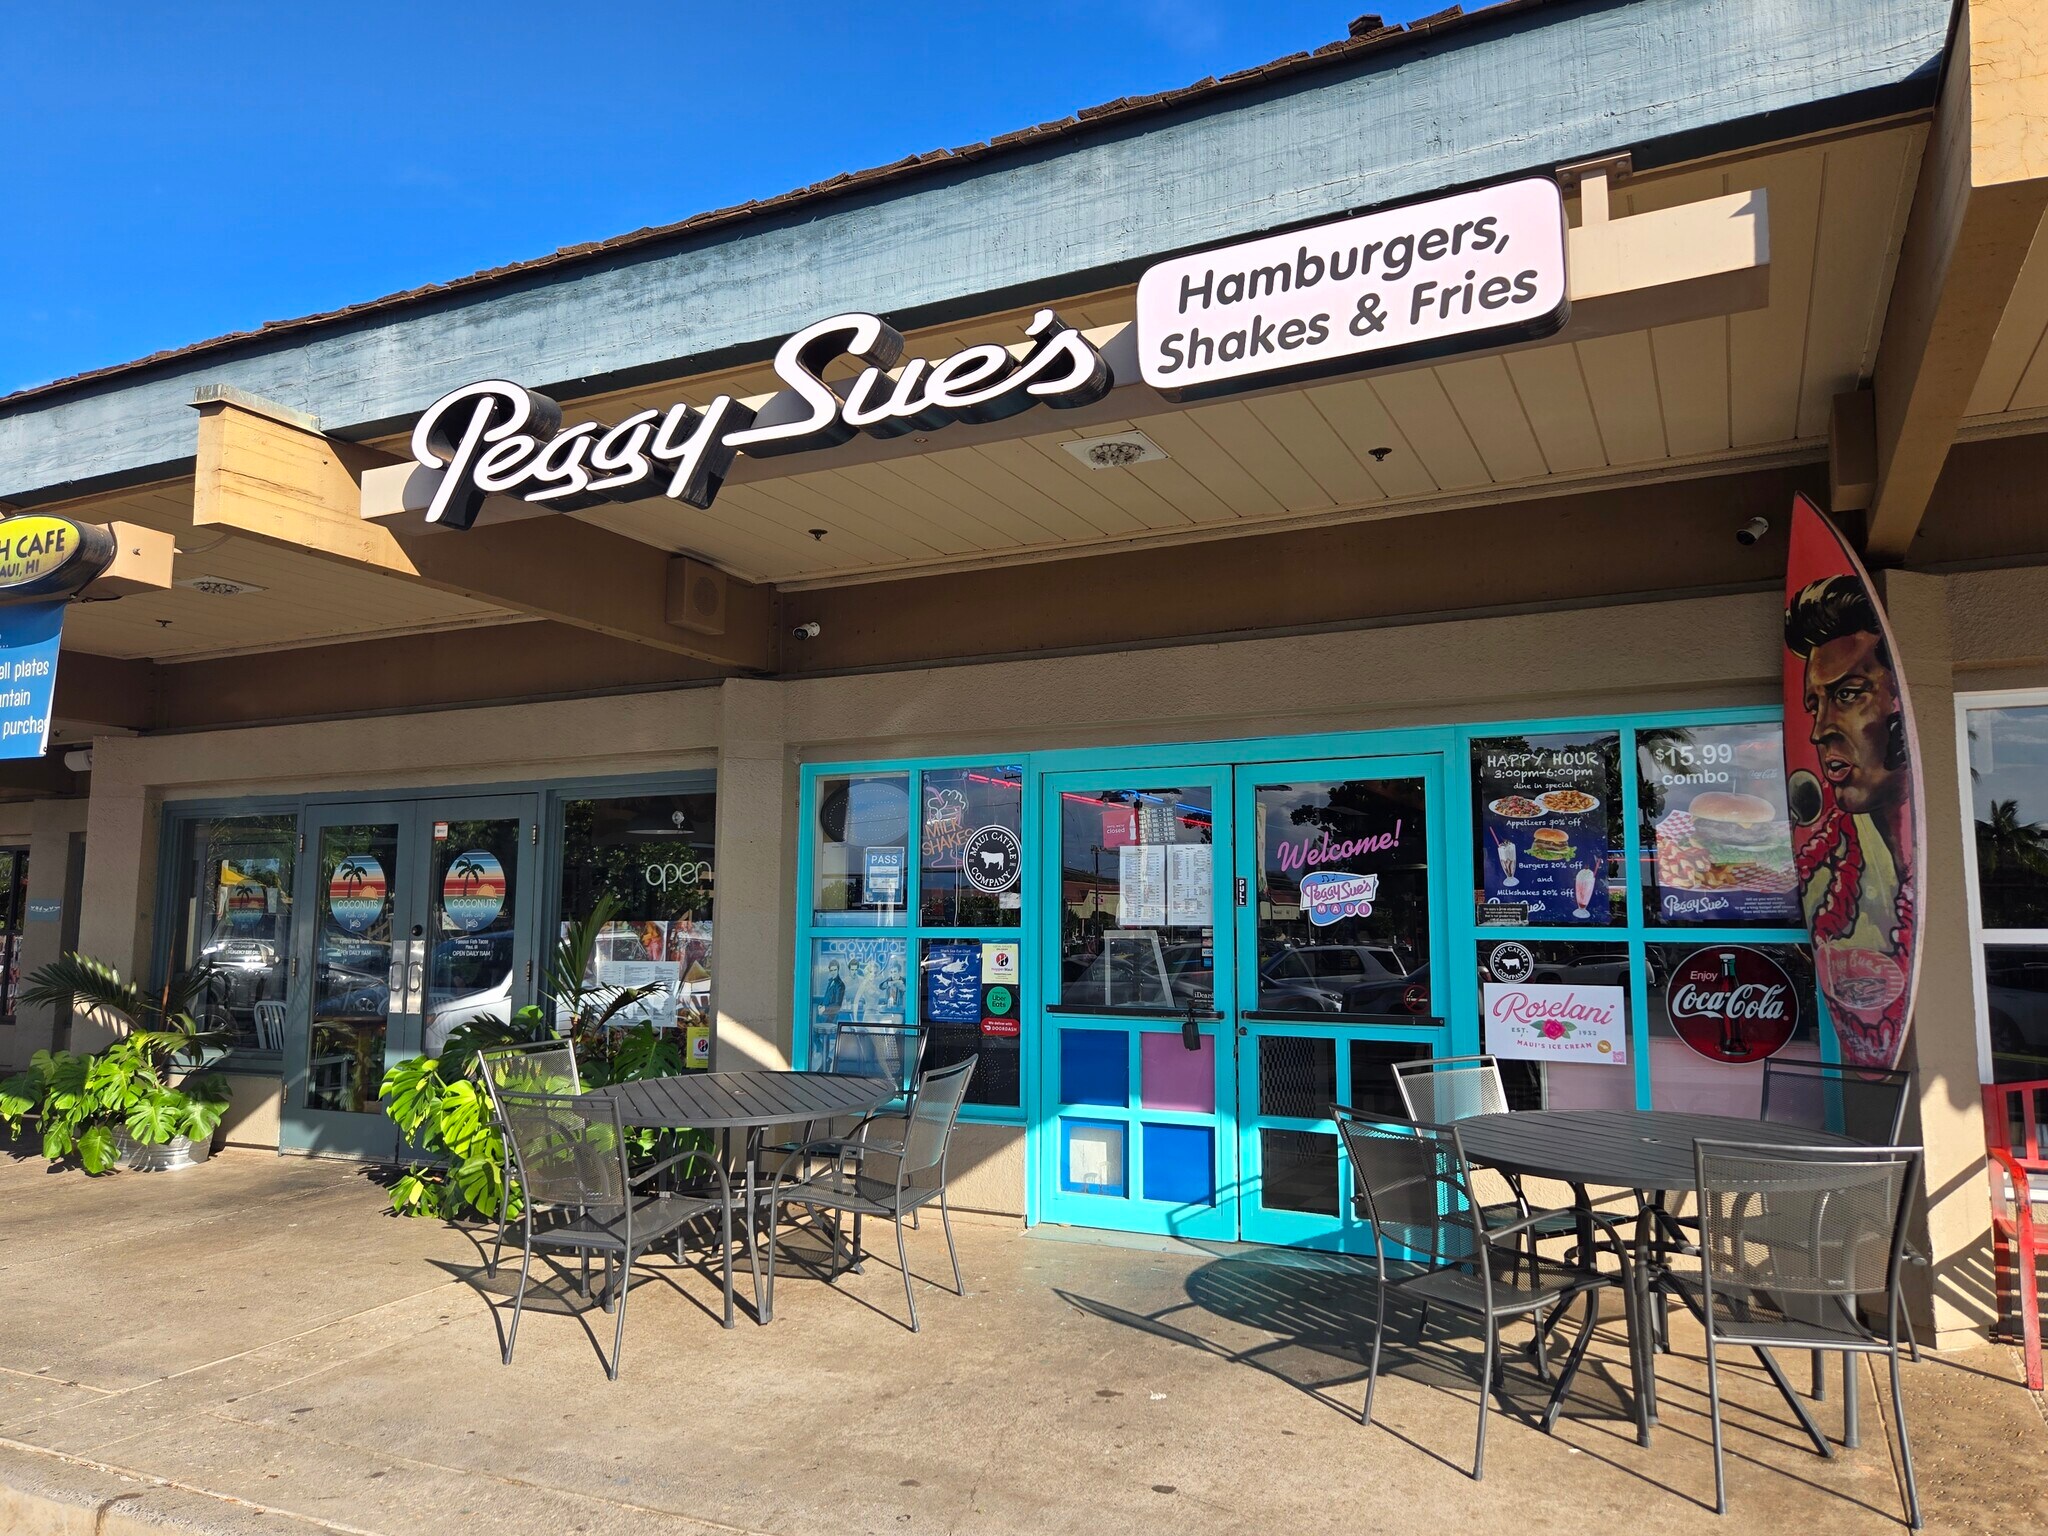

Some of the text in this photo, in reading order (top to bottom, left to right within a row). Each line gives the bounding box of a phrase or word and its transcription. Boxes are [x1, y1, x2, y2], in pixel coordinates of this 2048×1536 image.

[1178, 216, 1510, 314] Hamburgers,
[1157, 269, 1538, 375] Shakes & Fries
[411, 309, 1097, 522] Peggy Sue's
[16, 528, 66, 558] CAFE
[25, 559, 40, 574] HI
[14, 658, 49, 682] plates
[1487, 751, 1600, 768] HAPPY HOUR
[1655, 743, 1732, 767] $15.99
[1494, 768, 1593, 783] 3:00pm-6:00pm
[1662, 769, 1729, 786] combo
[1545, 782, 1573, 791] special
[924, 819, 962, 839] MILK
[1506, 820, 1546, 829] Appetizers
[1567, 818, 1581, 826] off
[969, 831, 1016, 860] MAUI CATTLE
[1277, 819, 1402, 872] Welcome!
[871, 855, 898, 864] PASS
[1518, 862, 1548, 870] Burgers
[1569, 861, 1583, 869] off
[646, 861, 711, 892] open
[971, 866, 1011, 887] COMPANY
[1303, 880, 1372, 906] Peggy Sue's
[1561, 888, 1575, 897] off
[337, 900, 379, 909] COCONUTS
[452, 898, 497, 908] COCONUTS
[1317, 903, 1367, 913] MAUI
[1664, 895, 1729, 916] Peggy Sue's
[1495, 946, 1528, 963] MAUI CATTLE
[1497, 968, 1527, 980] COMPANY
[1690, 971, 1718, 981] Enjoy
[1493, 992, 1615, 1025] Roselani
[1672, 983, 1788, 1019] Coca-Cola
[1516, 1040, 1545, 1049] MAUI'S
